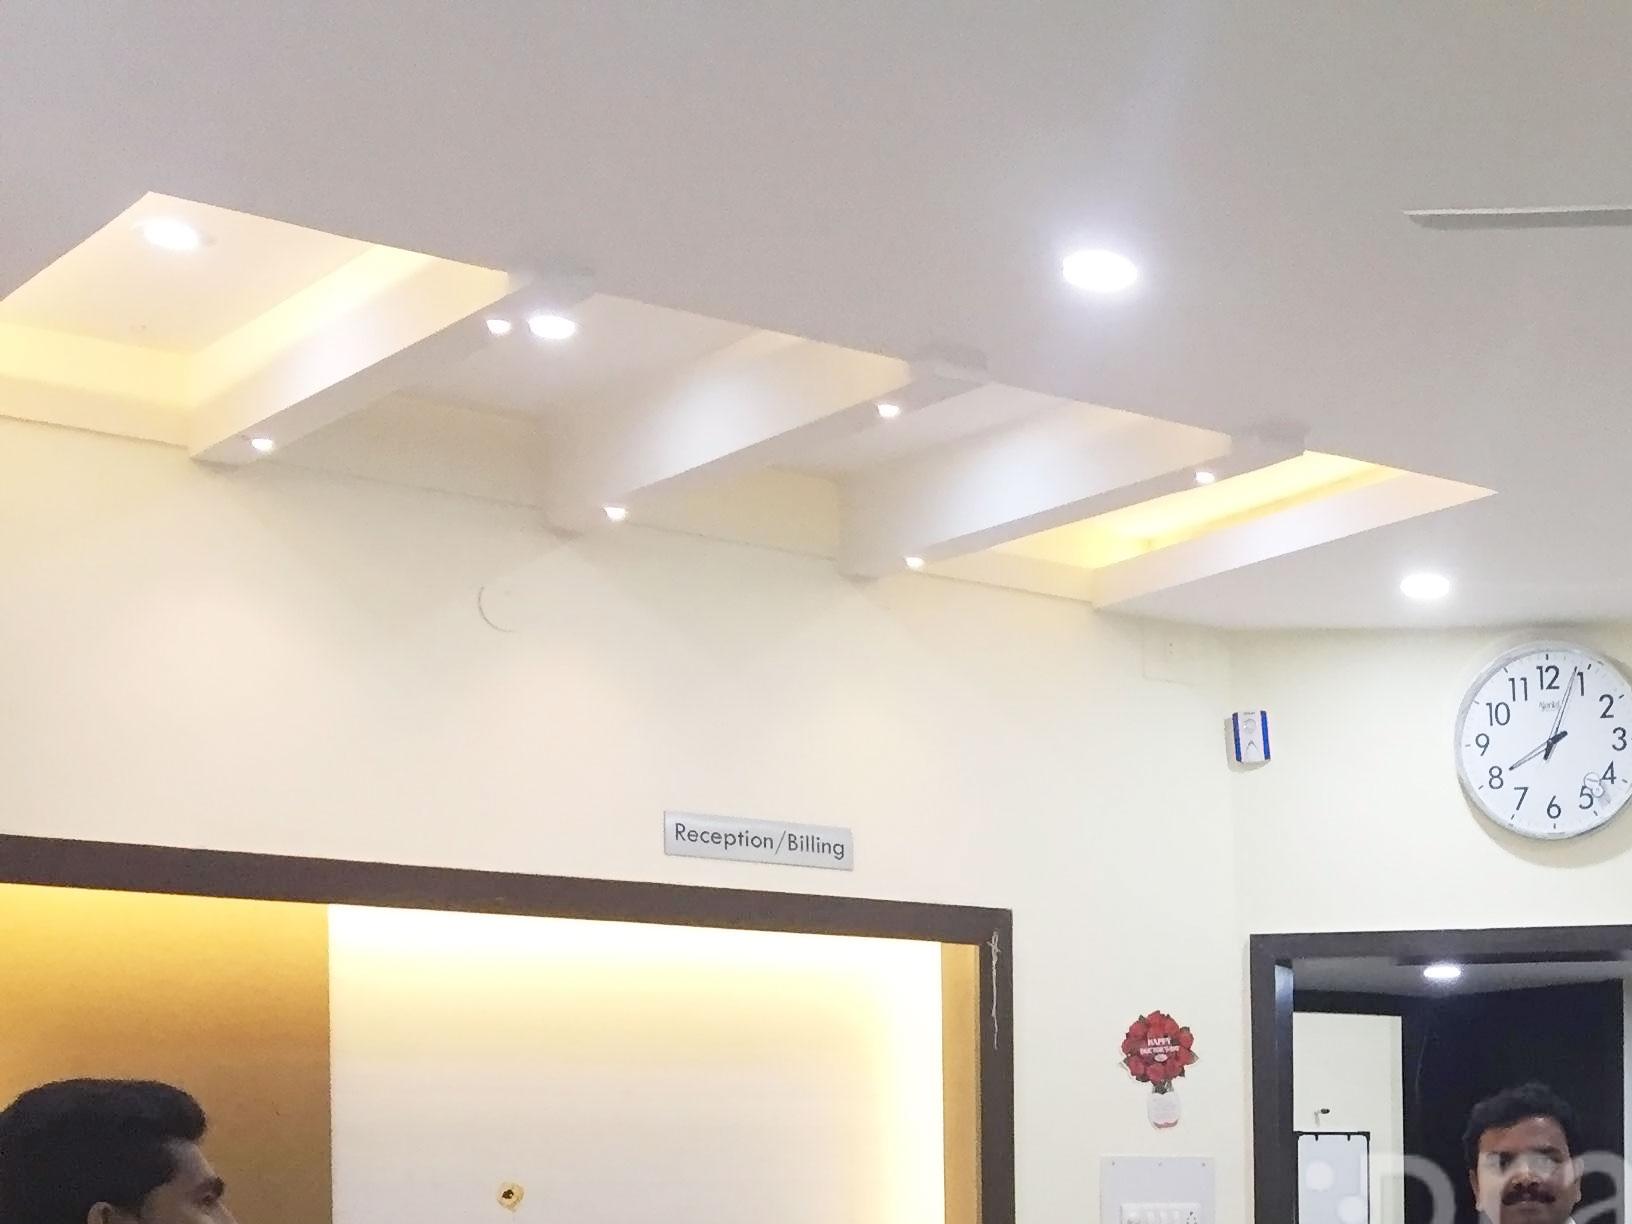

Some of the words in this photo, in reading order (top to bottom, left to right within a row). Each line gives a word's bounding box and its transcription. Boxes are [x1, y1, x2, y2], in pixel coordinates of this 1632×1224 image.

[1508, 677, 1528, 701] 11
[1536, 665, 1560, 690] 12
[1577, 671, 1585, 696] 1
[1486, 701, 1511, 726] 10
[1599, 694, 1615, 718] 2
[1475, 733, 1490, 756] 9
[1612, 726, 1627, 751] 3
[1488, 765, 1504, 790] 8
[1602, 761, 1616, 784] 4
[1514, 786, 1528, 811] 7
[1547, 795, 1562, 819] 6
[1579, 786, 1594, 810] 5
[675, 822, 845, 861] Reception/Billing
